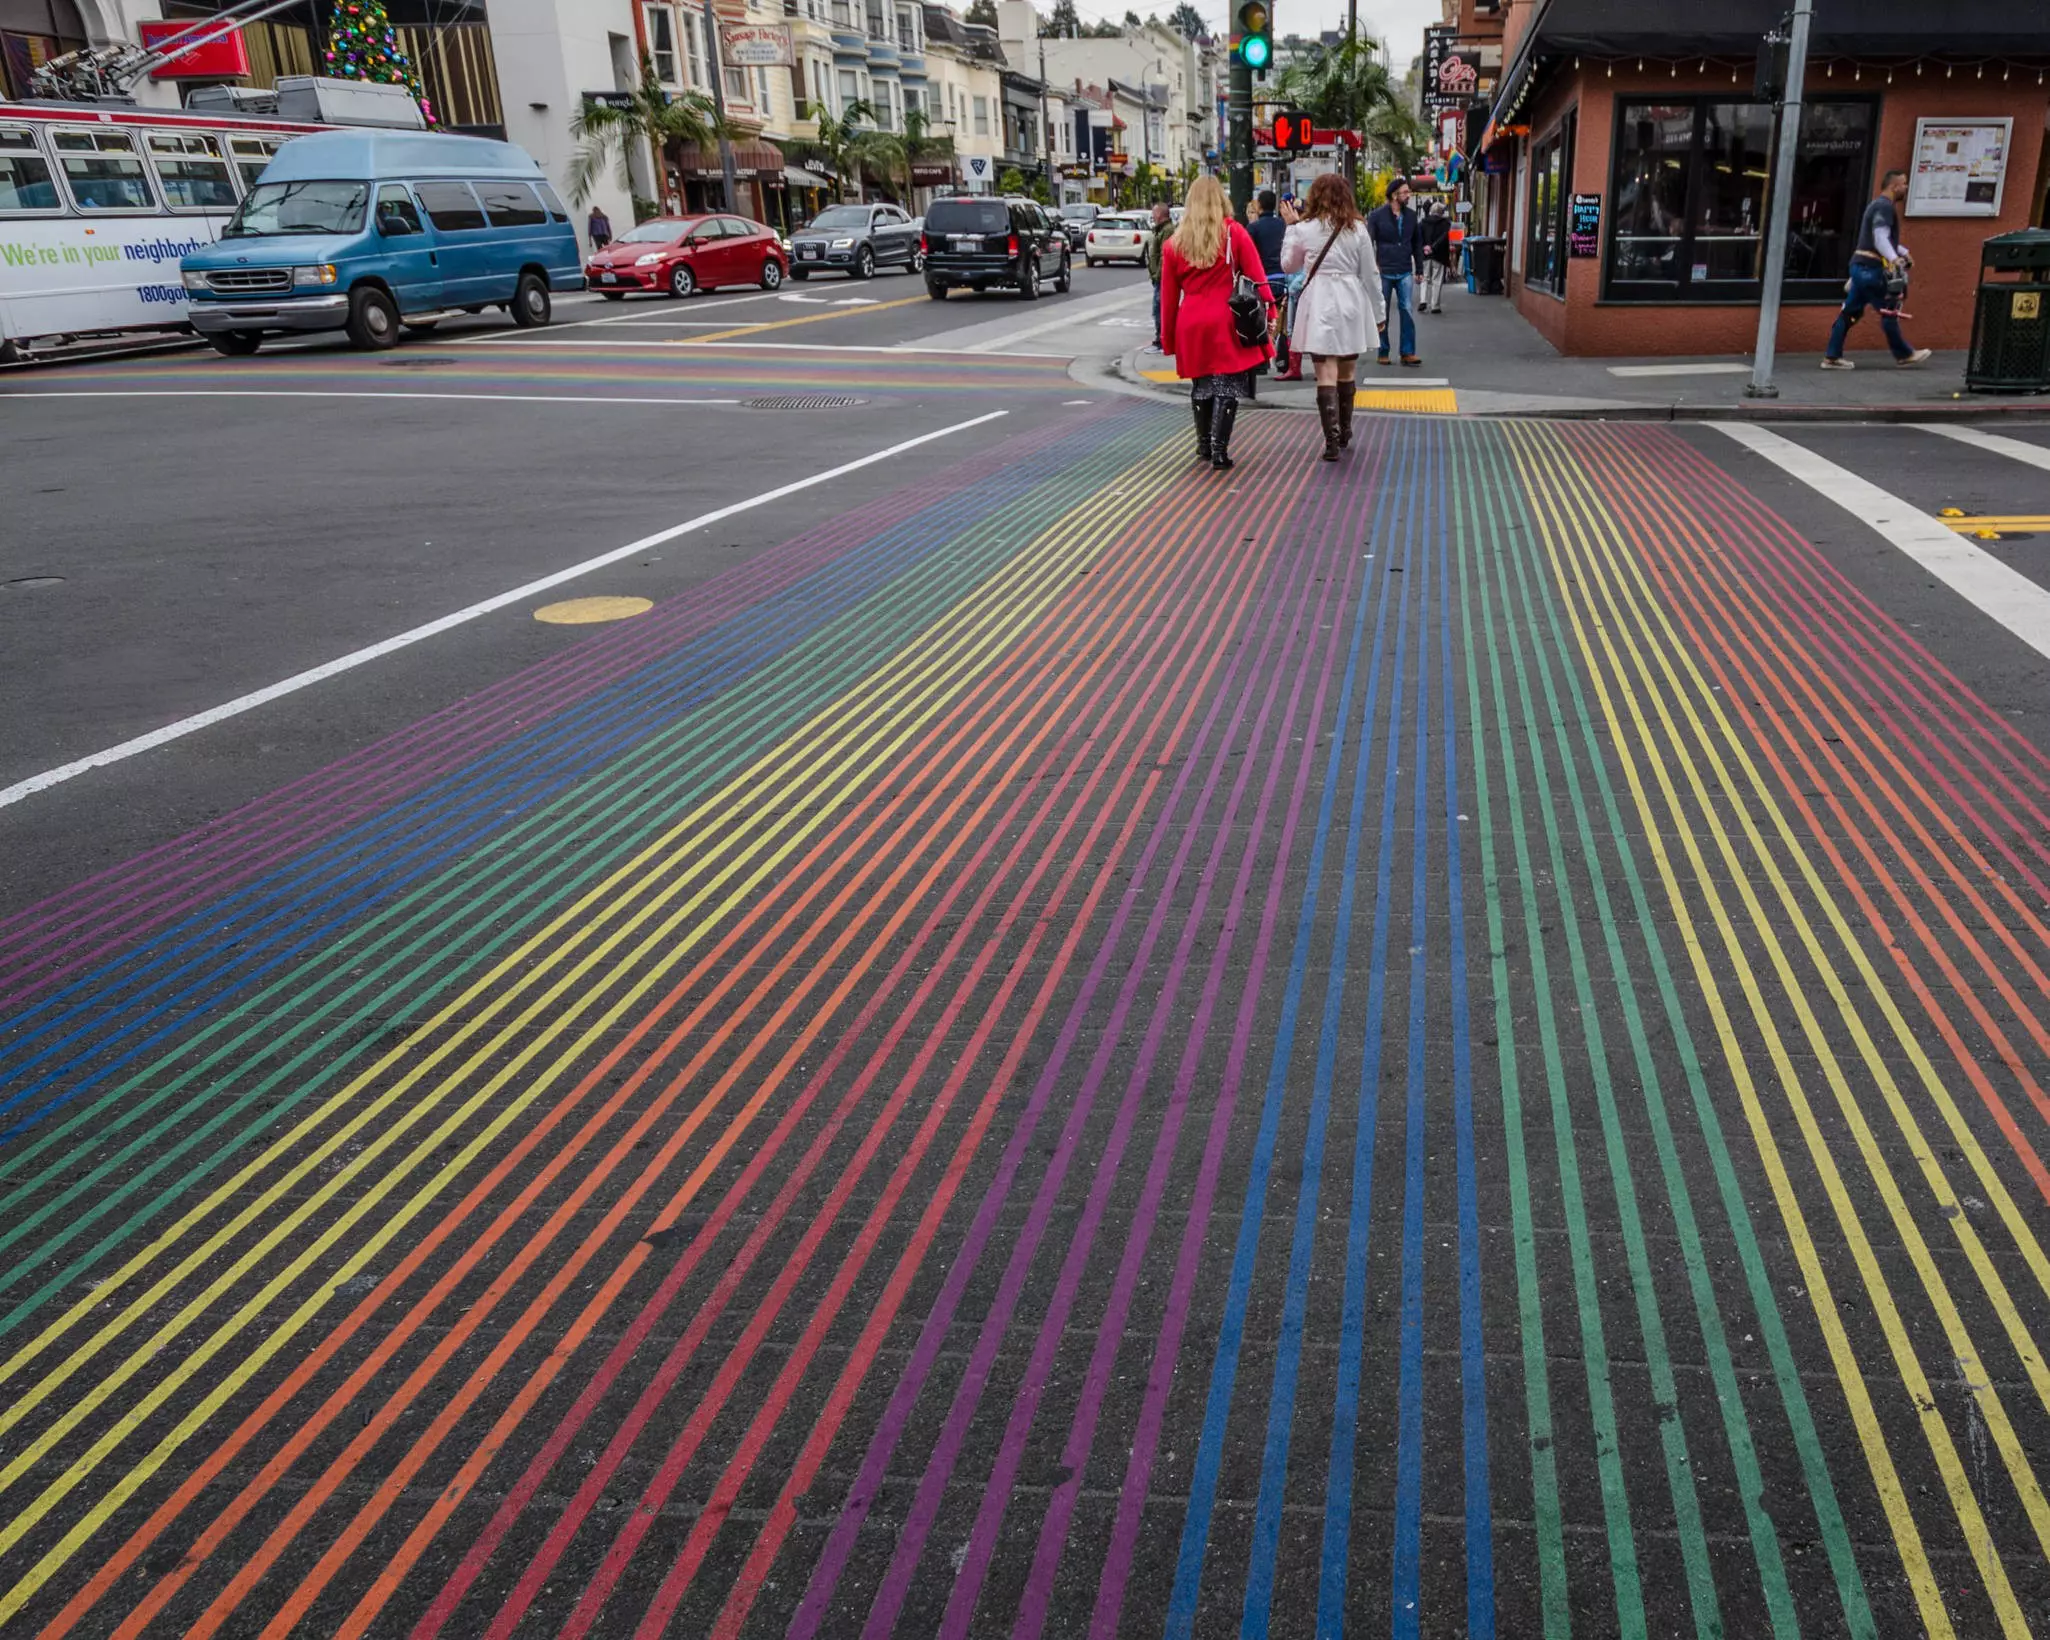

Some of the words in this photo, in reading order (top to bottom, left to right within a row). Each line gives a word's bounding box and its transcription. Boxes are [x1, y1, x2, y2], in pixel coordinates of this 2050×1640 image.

[1301, 118, 1311, 145] 0
[0, 243, 59, 266] We're
[60, 241, 81, 264] in
[82, 245, 120, 269] your
[124, 237, 208, 264] neighborh
[136, 285, 190, 304] 1800got
